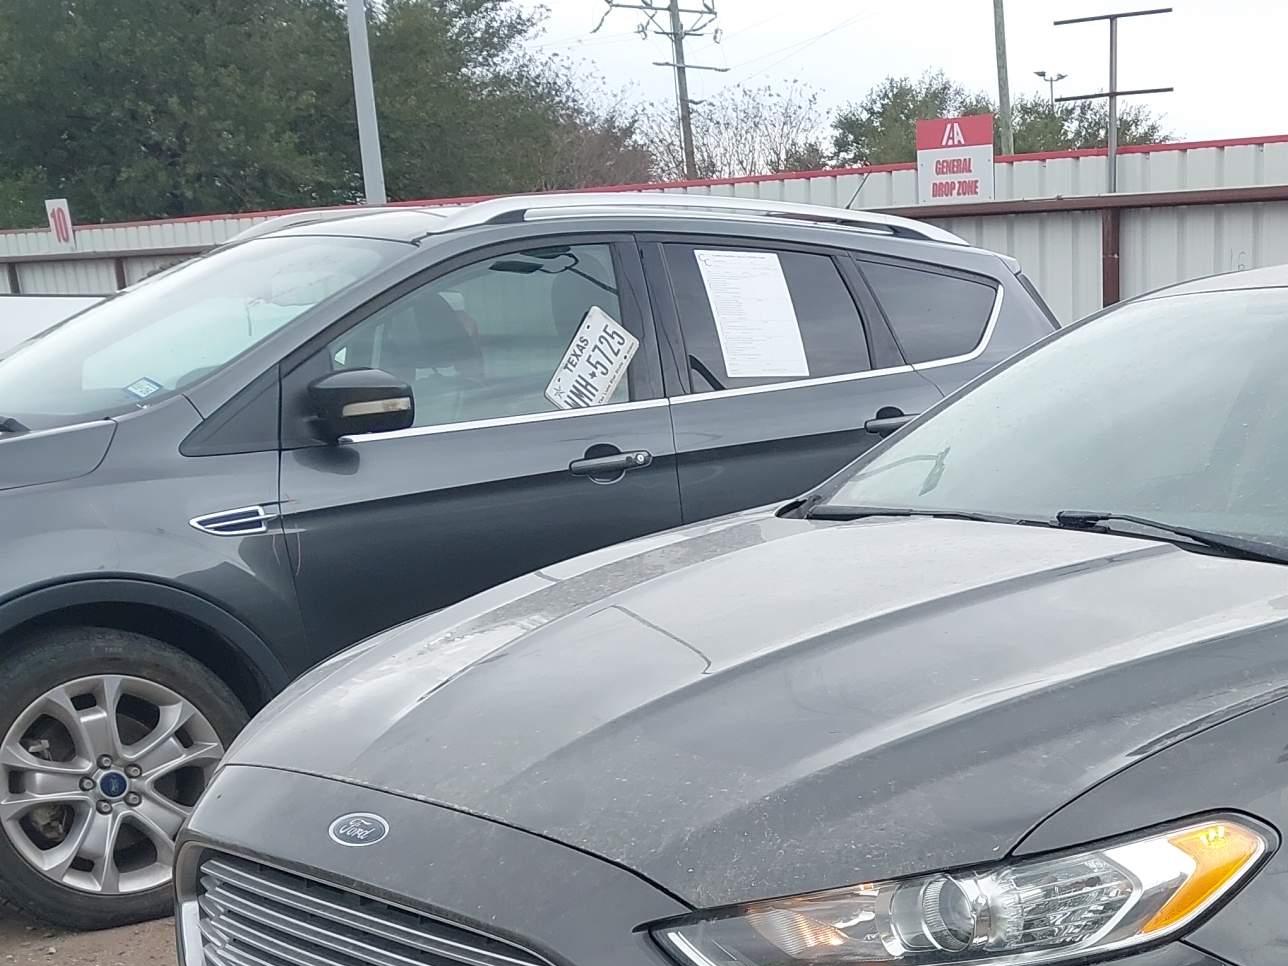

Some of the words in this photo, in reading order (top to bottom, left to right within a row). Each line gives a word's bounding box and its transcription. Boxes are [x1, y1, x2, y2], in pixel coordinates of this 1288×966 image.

[935, 158, 972, 176] GENERAL
[932, 181, 956, 198] DROP
[957, 179, 979, 196] ZONE
[51, 207, 70, 243] 10
[563, 336, 589, 373] TEXAS
[339, 819, 376, 839] Ford
